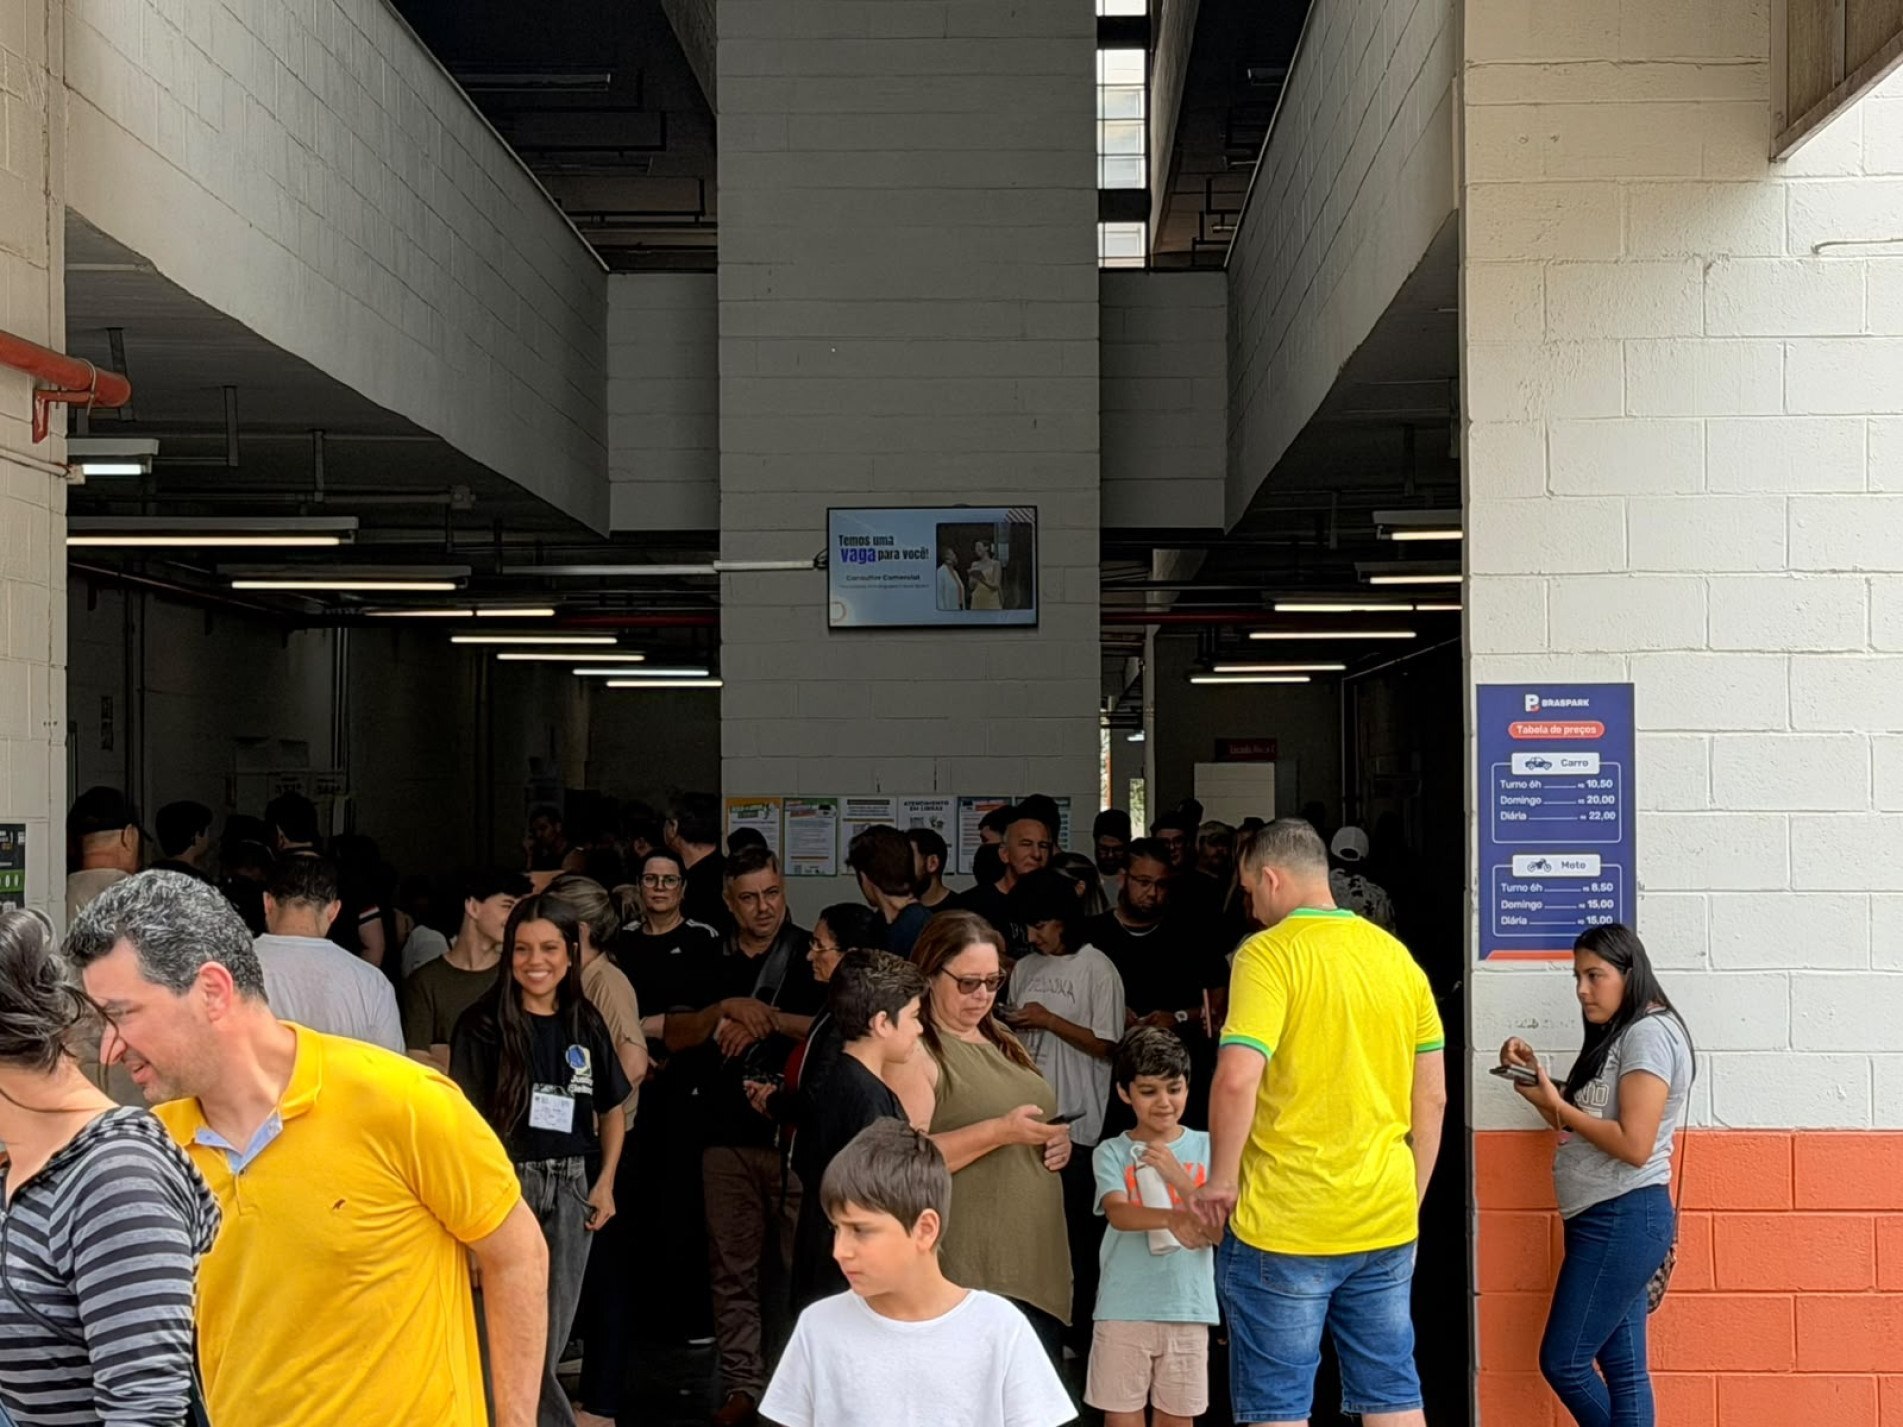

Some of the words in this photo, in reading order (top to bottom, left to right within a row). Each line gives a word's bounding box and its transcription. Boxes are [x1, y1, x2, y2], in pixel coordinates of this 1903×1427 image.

[839, 534, 871, 547] Temos
[873, 535, 894, 546] uma
[840, 547, 876, 564] vaga
[878, 549, 900, 561] para
[902, 546, 929, 560] você!
[1541, 698, 1590, 707] BRASPARK
[1516, 725, 1548, 734] Tabela
[1550, 725, 1562, 734] de
[1563, 726, 1597, 735] preços
[1560, 758, 1589, 767] Carro
[1500, 779, 1527, 789] Turno
[1529, 779, 1542, 789] 6h
[1500, 795, 1542, 806] Domingo
[1500, 811, 1527, 820] Diária
[1561, 861, 1586, 869] Moto
[1501, 882, 1528, 892] Turno
[1530, 882, 1543, 892] 6h
[1501, 900, 1543, 911] Domingo
[1501, 915, 1528, 925] Diária
